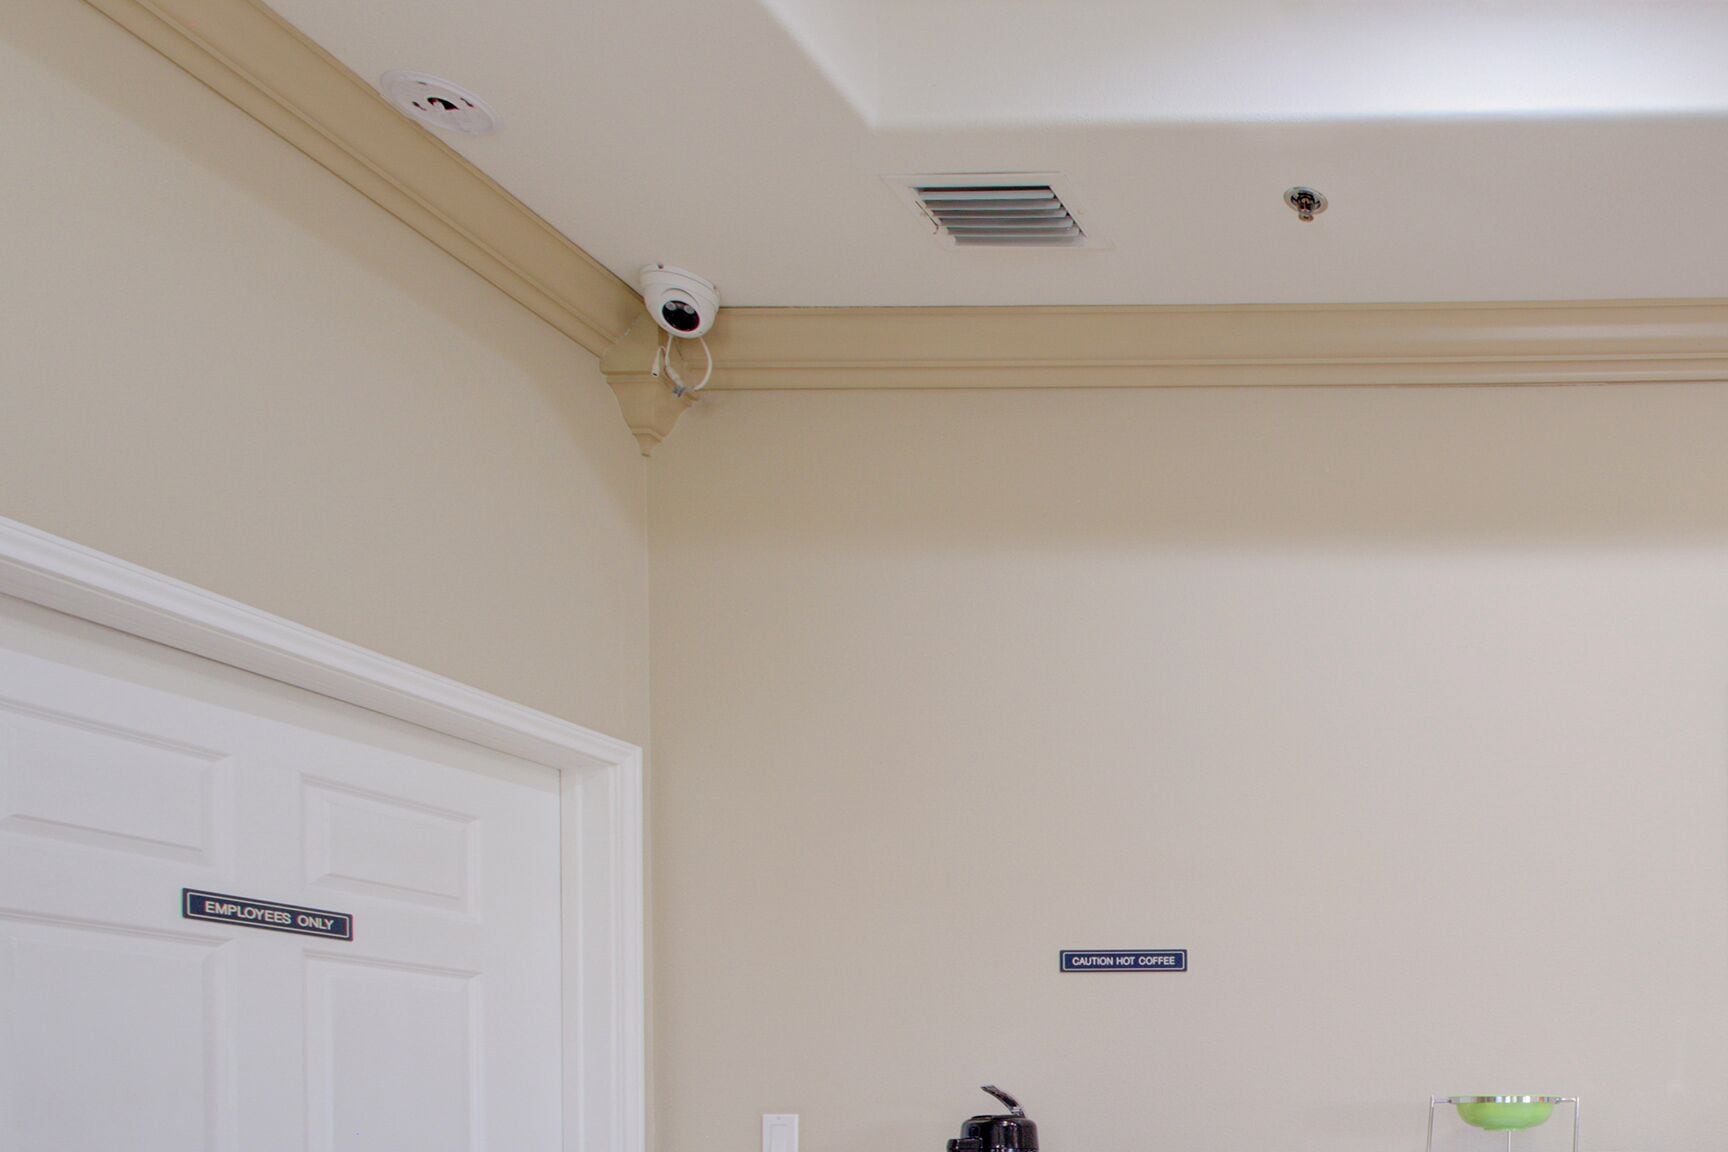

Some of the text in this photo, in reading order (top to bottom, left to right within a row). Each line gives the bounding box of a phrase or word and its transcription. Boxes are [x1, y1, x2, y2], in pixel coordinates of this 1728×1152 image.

[204, 900, 335, 931] EMPLOYEES ONLY
[1072, 956, 1176, 966] CAUTION HOT COFFEE
